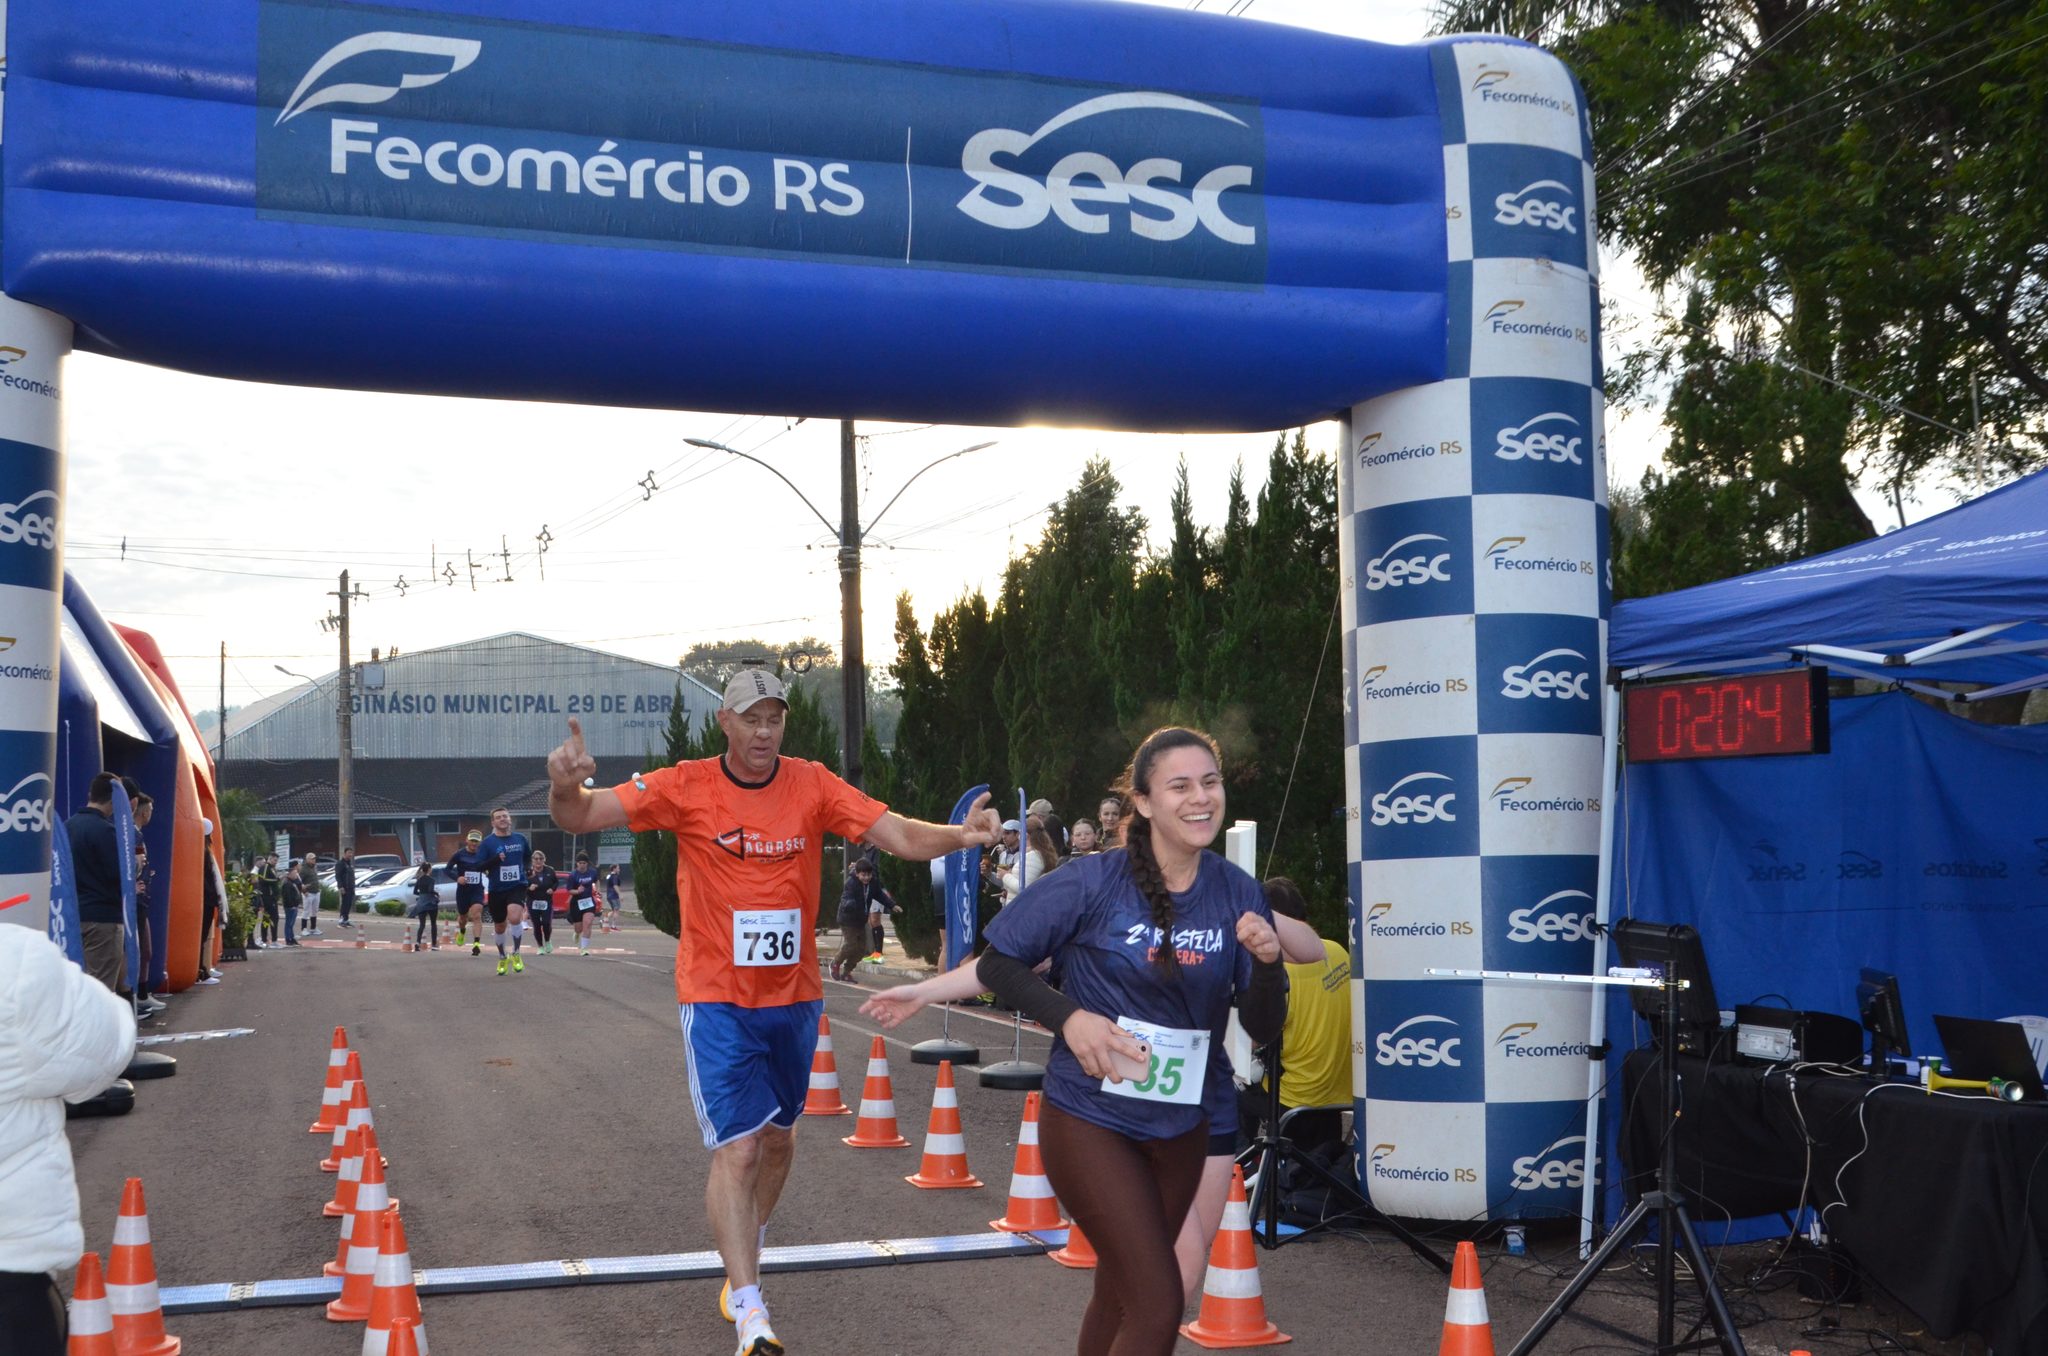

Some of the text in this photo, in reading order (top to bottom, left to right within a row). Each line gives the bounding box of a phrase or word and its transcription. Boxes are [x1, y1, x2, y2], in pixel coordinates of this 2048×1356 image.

[1482, 88, 1575, 117] Fecomércio RS
[331, 118, 865, 217] Fecomércio RS
[956, 91, 1256, 246] Sesc
[1494, 180, 1577, 234] Sesc
[1492, 320, 1588, 344] Fecomércio RS
[1494, 412, 1582, 465] Sesc
[1361, 440, 1462, 469] Fecomércio RS
[1365, 534, 1451, 591] Sesc
[1494, 557, 1577, 573] Fecomércio
[1580, 560, 1594, 576] RS
[1500, 648, 1589, 700] Sesc
[350, 691, 691, 715] GINÁSIO MUNICIPAL 29 DE ABRL
[1366, 678, 1468, 701] Fecomércio RS
[1370, 772, 1456, 826] Sesc
[1500, 797, 1601, 812] Fecomércio RS
[502, 871, 518, 881] 894
[1371, 921, 1445, 937] Fecomércio
[1451, 921, 1473, 935] RS
[1506, 889, 1598, 943] Sesc
[743, 930, 794, 961] 736
[1375, 1015, 1461, 1067] Sesc
[1505, 1041, 1590, 1057] Fecomércio
[1374, 1163, 1450, 1182] Fecomércio
[1454, 1168, 1477, 1183] RS
